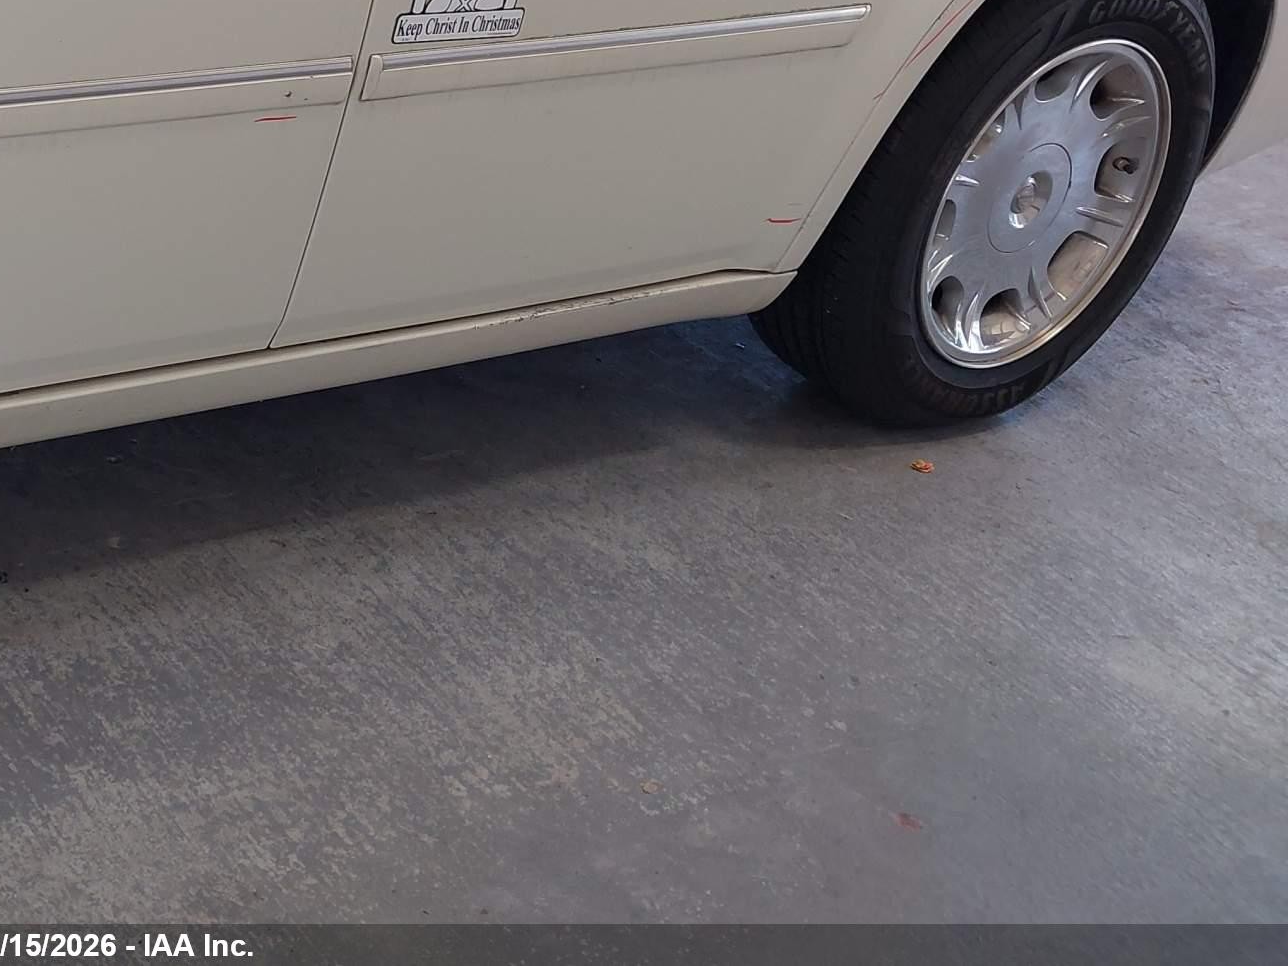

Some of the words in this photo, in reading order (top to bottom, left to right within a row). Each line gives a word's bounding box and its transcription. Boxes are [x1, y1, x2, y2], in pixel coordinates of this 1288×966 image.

[397, 19, 423, 41] Keep
[425, 17, 457, 35] Christ
[457, 16, 470, 33] In
[471, 14, 521, 33] Christmas
